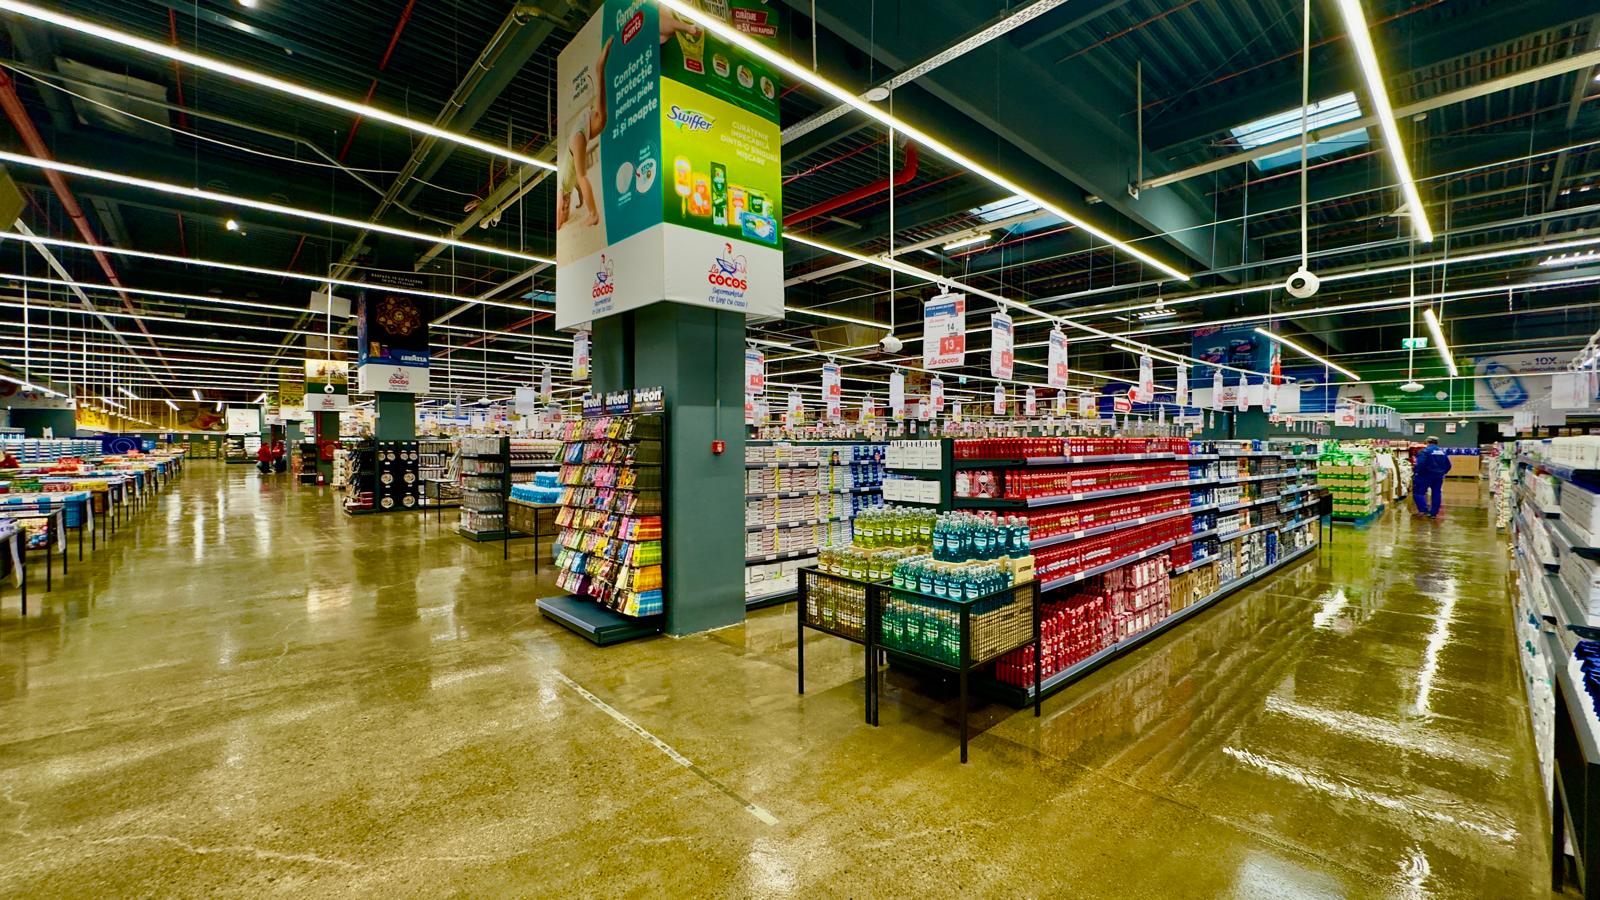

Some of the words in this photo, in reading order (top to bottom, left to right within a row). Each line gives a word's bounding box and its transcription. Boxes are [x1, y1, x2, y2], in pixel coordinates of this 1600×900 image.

[742, 23, 751, 33] 5X
[614, 53, 643, 88] Confort
[645, 44, 653, 64] și
[615, 63, 653, 105] protecție
[615, 95, 637, 120] pentru
[637, 81, 654, 103] piele
[612, 123, 620, 140] zi
[627, 97, 658, 128] noapte
[667, 105, 713, 131] Swiffer
[708, 273, 748, 290] COCOS
[592, 283, 614, 298] COCOS
[945, 339, 955, 350] 13
[1535, 357, 1557, 365] 10X
[583, 398, 602, 408] areon
[606, 393, 629, 406] areon
[634, 389, 662, 403] areon
